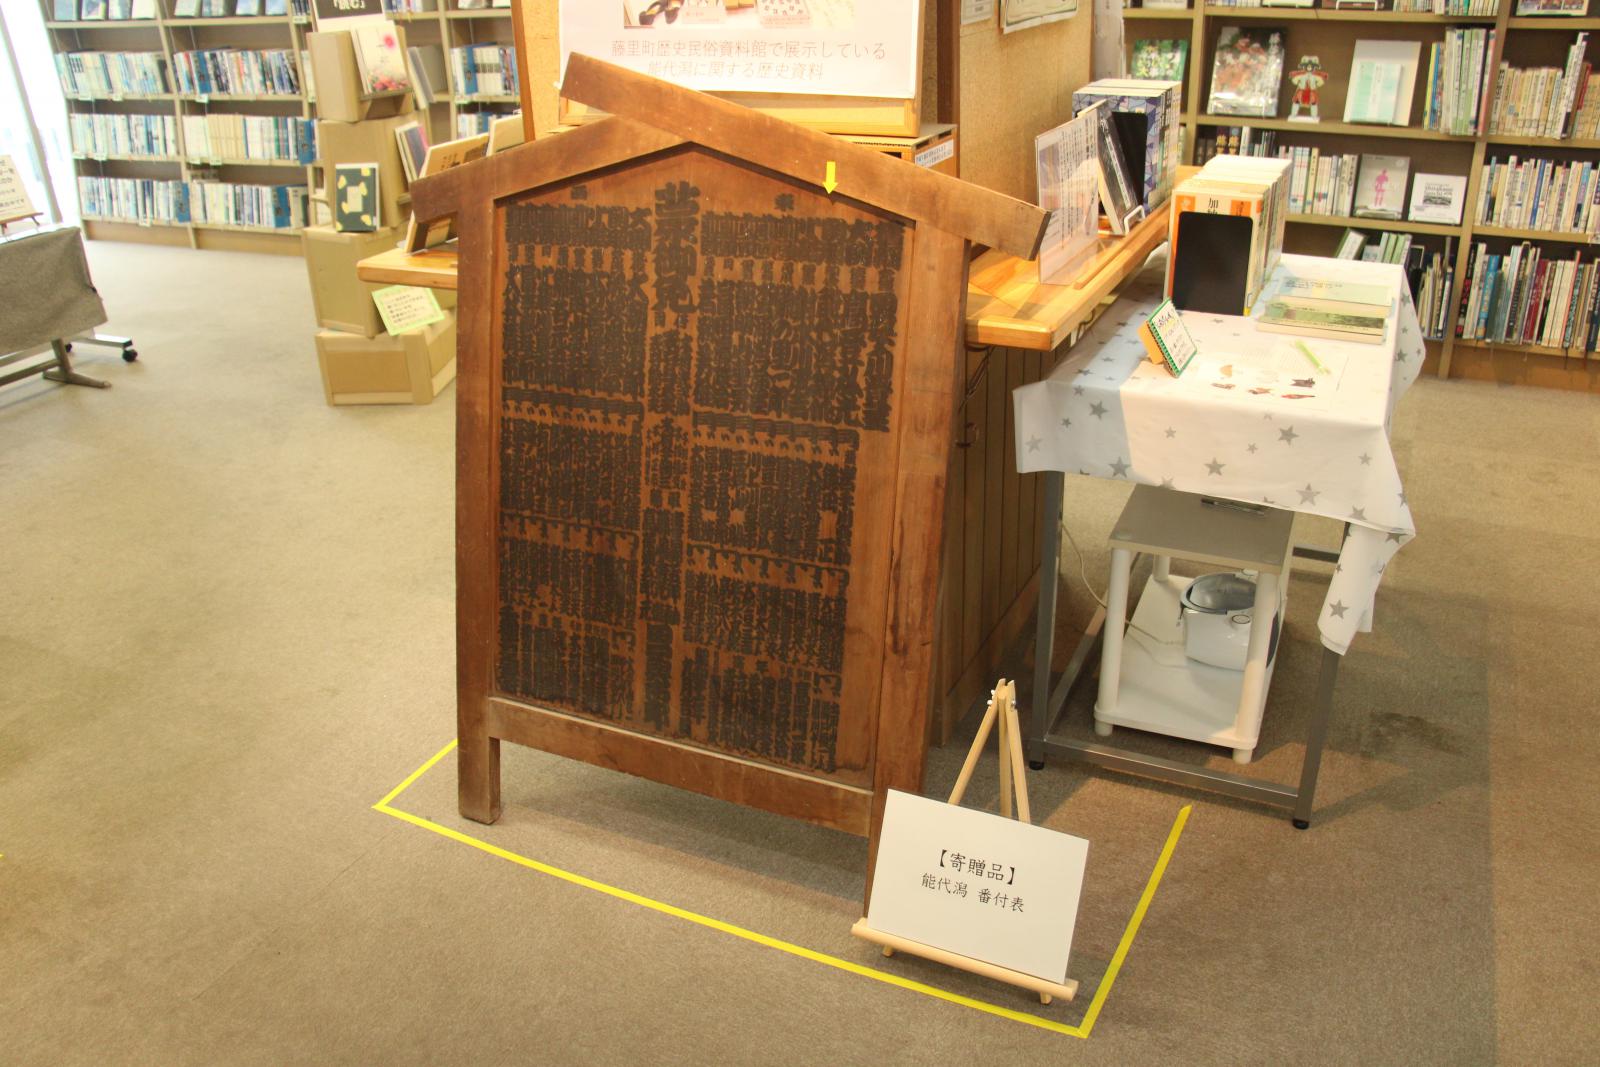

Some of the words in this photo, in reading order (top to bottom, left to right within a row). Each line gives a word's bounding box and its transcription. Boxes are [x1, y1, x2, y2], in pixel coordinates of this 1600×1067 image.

[610, 38, 887, 61] 藤里町歴史民俗資料館で展示している
[938, 849, 1016, 886] 【寄贈品】
[921, 872, 969, 898] 能代潟
[977, 887, 1025, 913] 番付表
